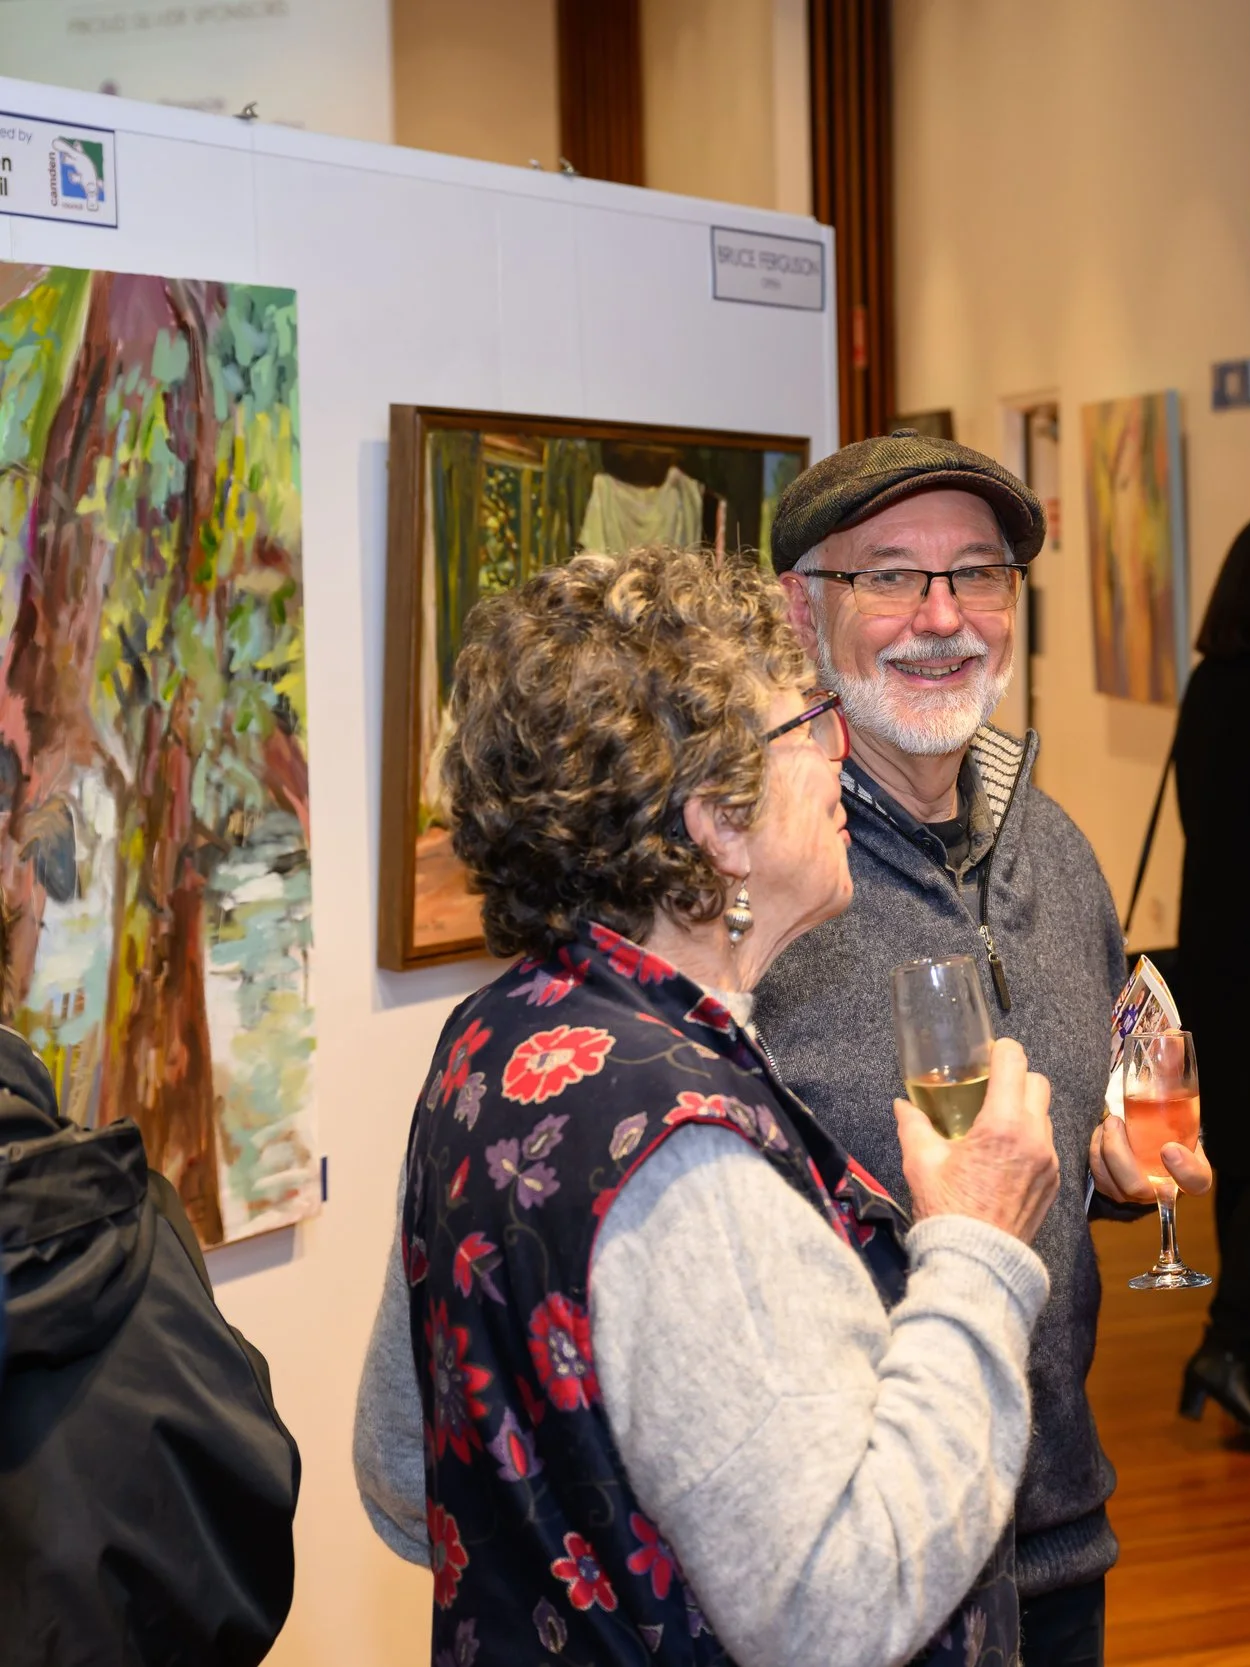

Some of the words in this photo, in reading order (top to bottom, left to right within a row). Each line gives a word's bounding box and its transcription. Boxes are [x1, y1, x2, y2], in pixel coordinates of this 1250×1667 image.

[18, 129, 32, 145] by
[48, 152, 58, 207] camden
[717, 245, 756, 268] BRUCE
[758, 251, 821, 276] FERGUSON
